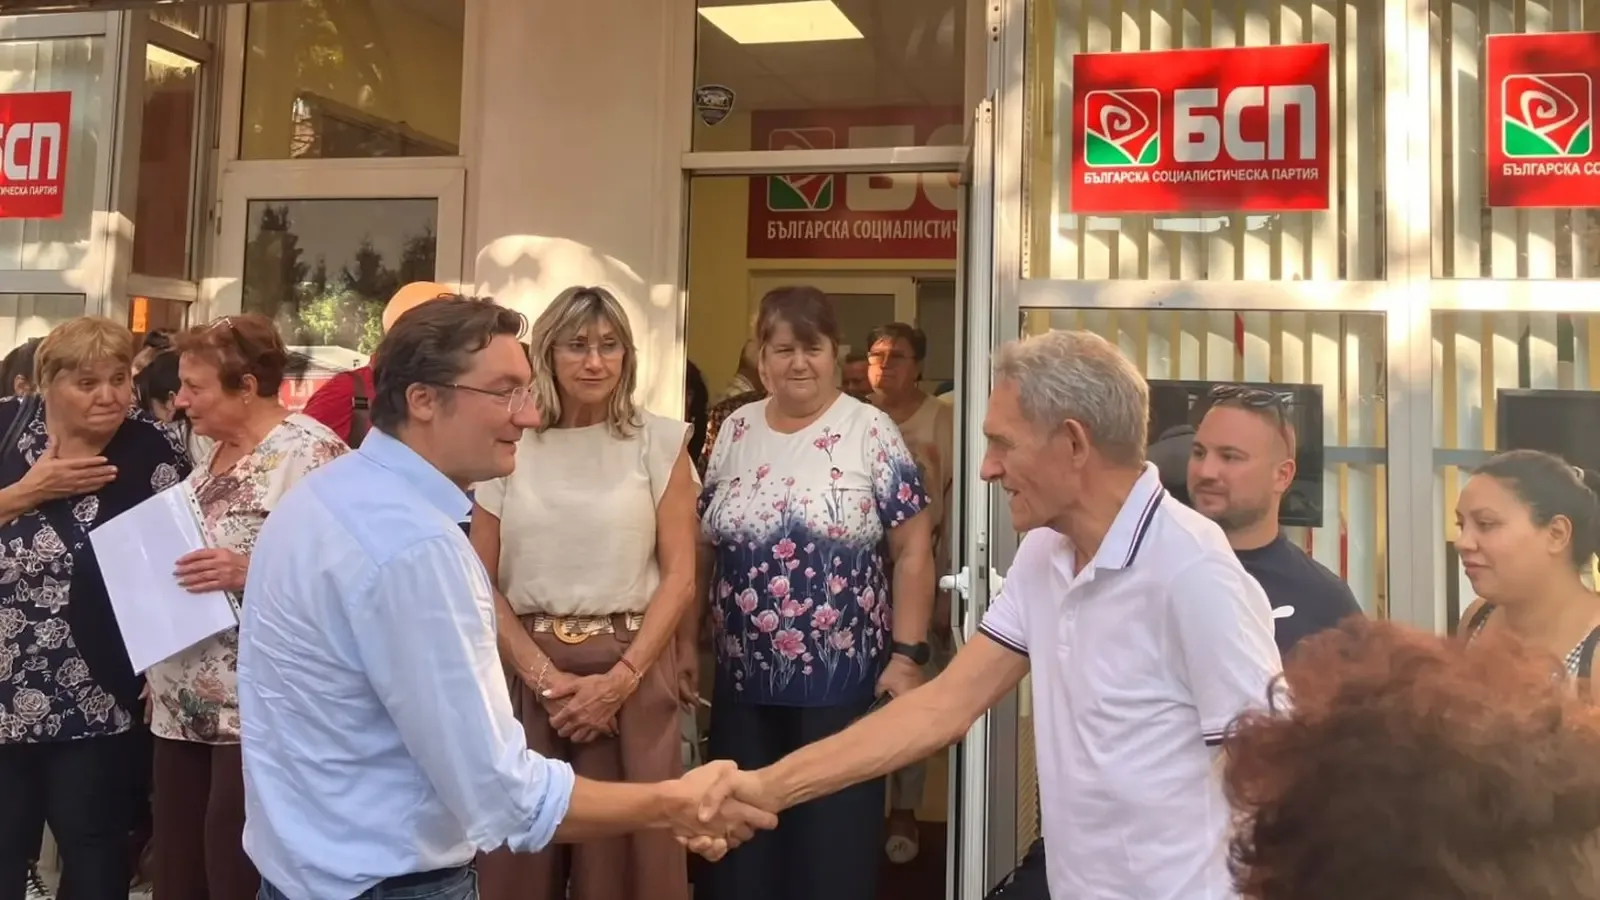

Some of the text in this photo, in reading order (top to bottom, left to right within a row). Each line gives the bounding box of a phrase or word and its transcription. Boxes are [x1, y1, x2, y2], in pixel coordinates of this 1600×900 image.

[1173, 84, 1317, 163] БСП
[0, 121, 62, 180] СП
[1083, 167, 1319, 184] БЪЛГАРСКА СОЦИАЛИСТИЧЕСКА ПАРТИЯ
[1503, 162, 1581, 176] БЪЛГАРСКА
[0, 185, 58, 196] ИЧЕСКА ПАРТИЯ
[767, 220, 849, 239] БЪЛГАРСКА
